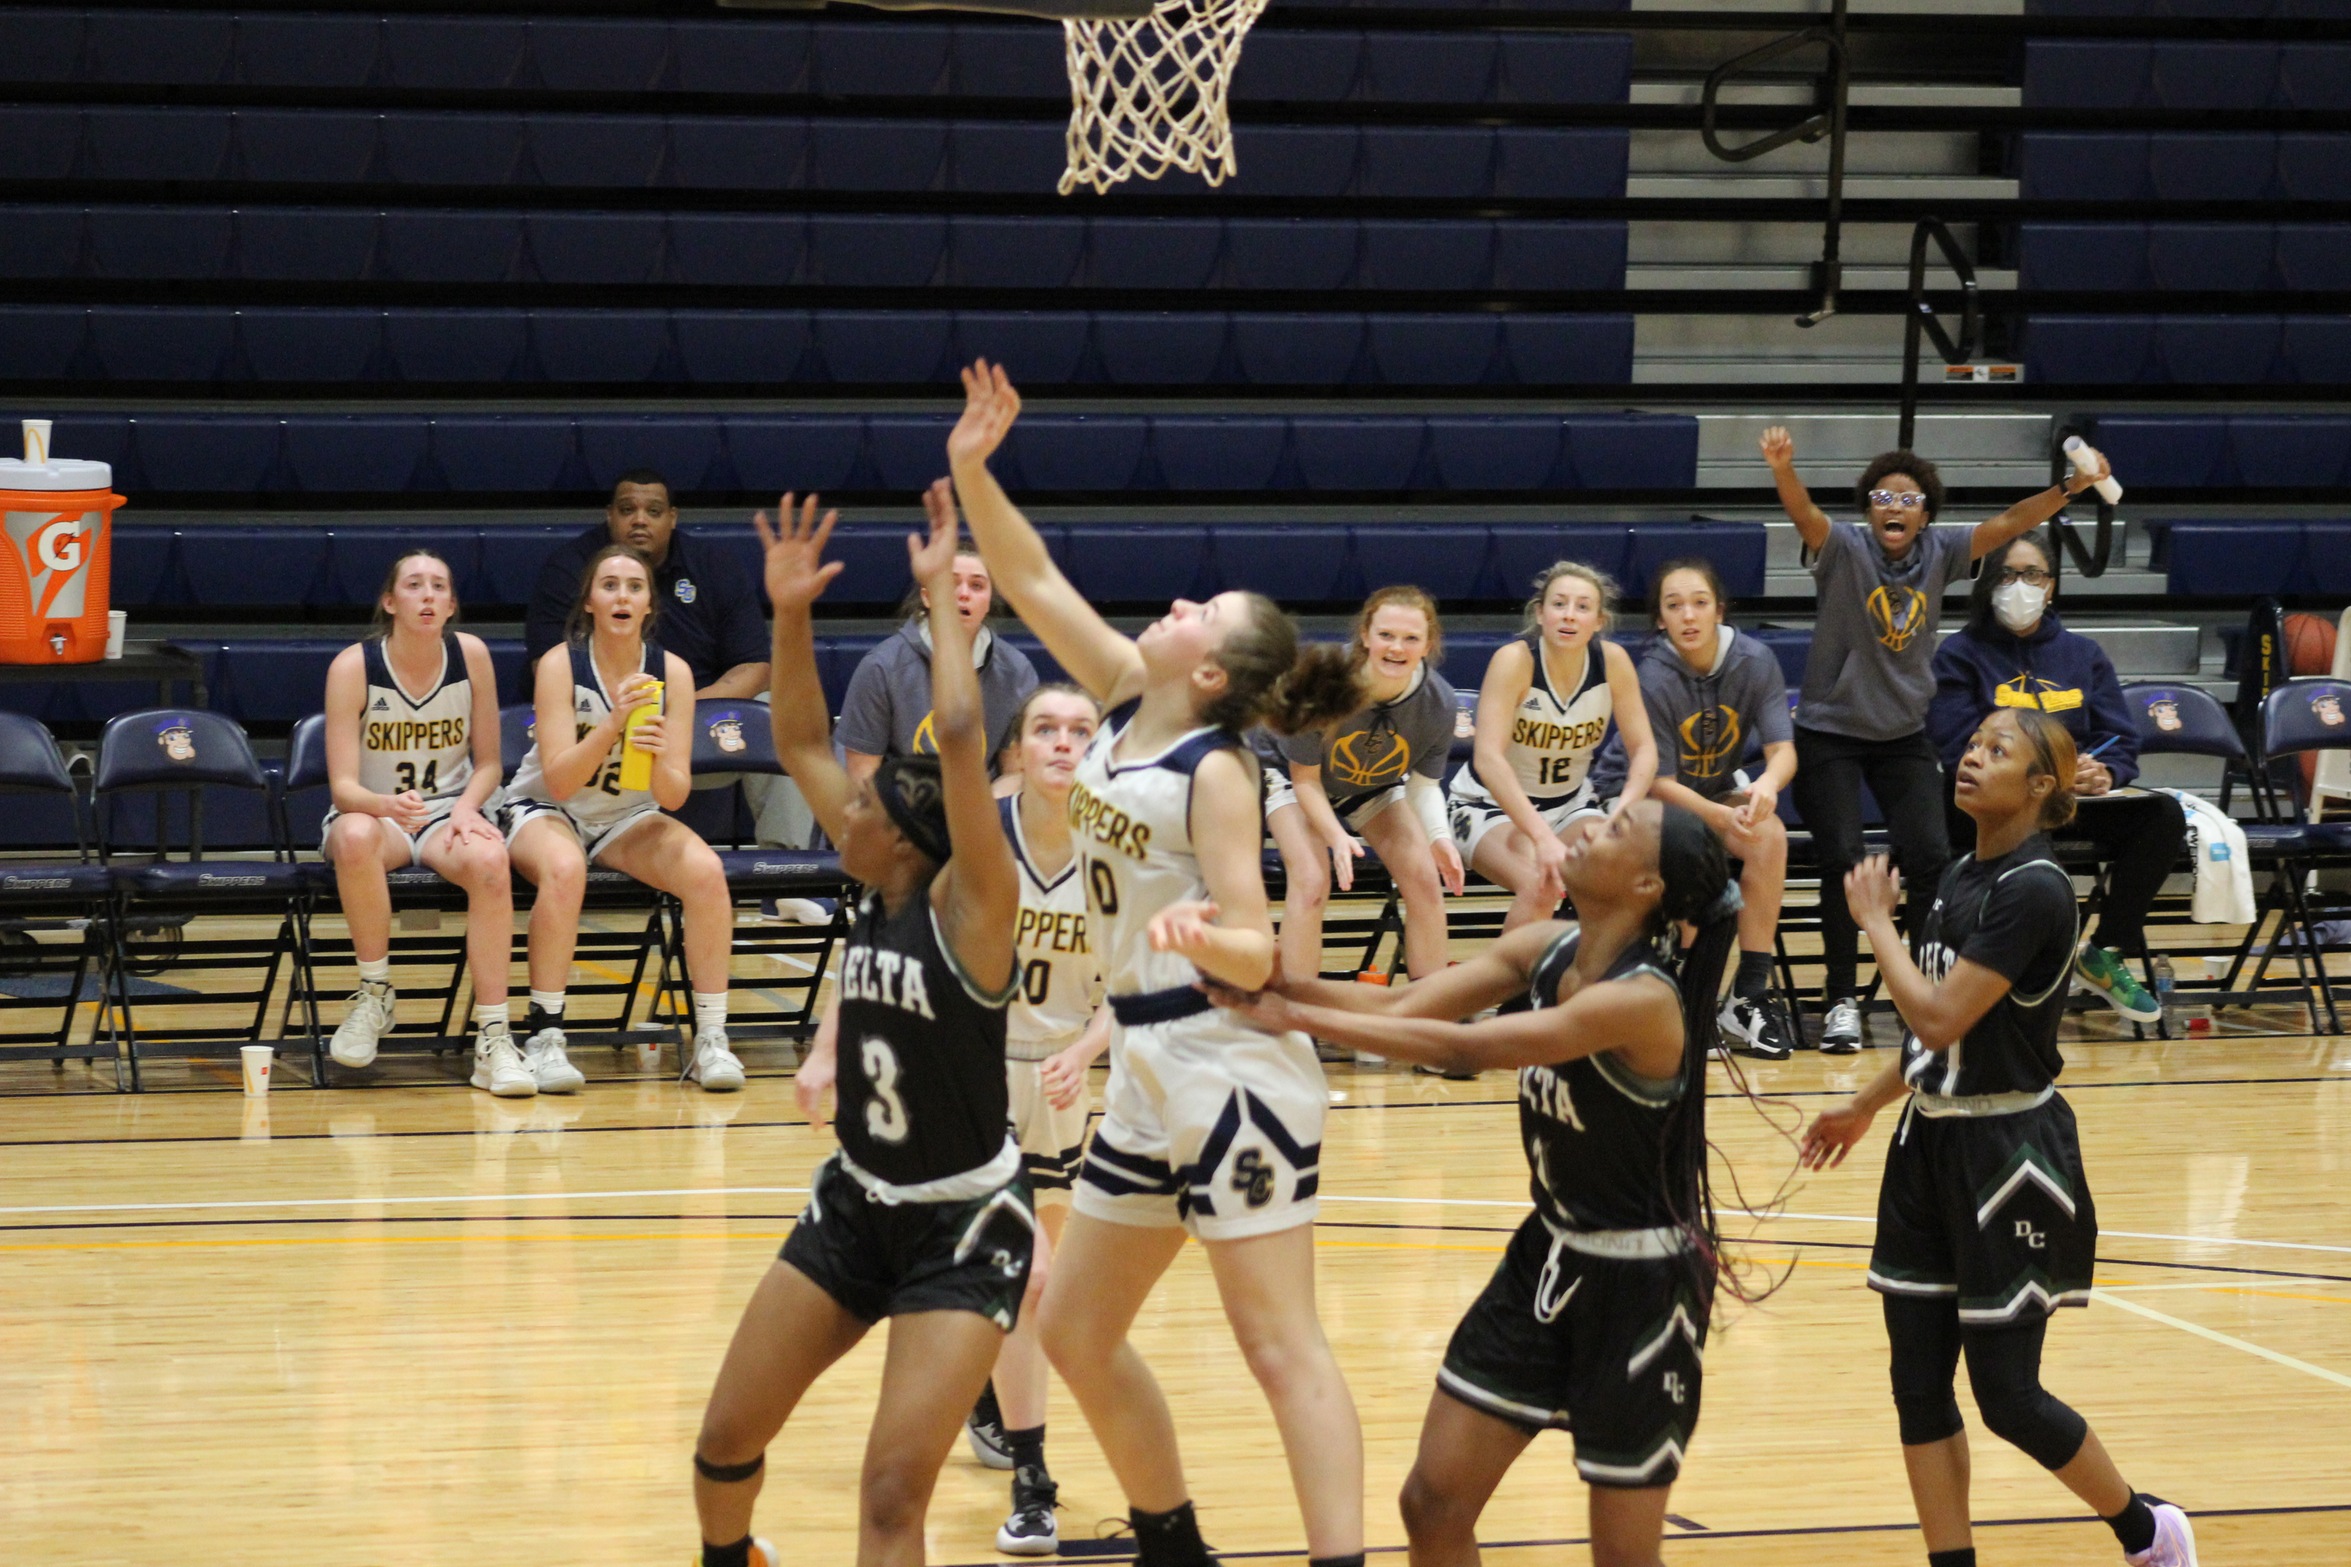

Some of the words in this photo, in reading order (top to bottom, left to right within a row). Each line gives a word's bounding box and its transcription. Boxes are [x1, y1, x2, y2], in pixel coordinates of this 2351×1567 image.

[38, 521, 80, 571] G
[367, 717, 464, 751] SKIPPERS
[1512, 717, 1604, 750] SKIPPERS
[395, 759, 438, 795] 34
[1539, 757, 1571, 785] 12
[1014, 907, 1091, 954] PPER
[1023, 958, 1051, 1006] 0
[861, 1037, 909, 1142] 3
[1230, 1146, 1276, 1209] SC
[2014, 1220, 2046, 1249] DC
